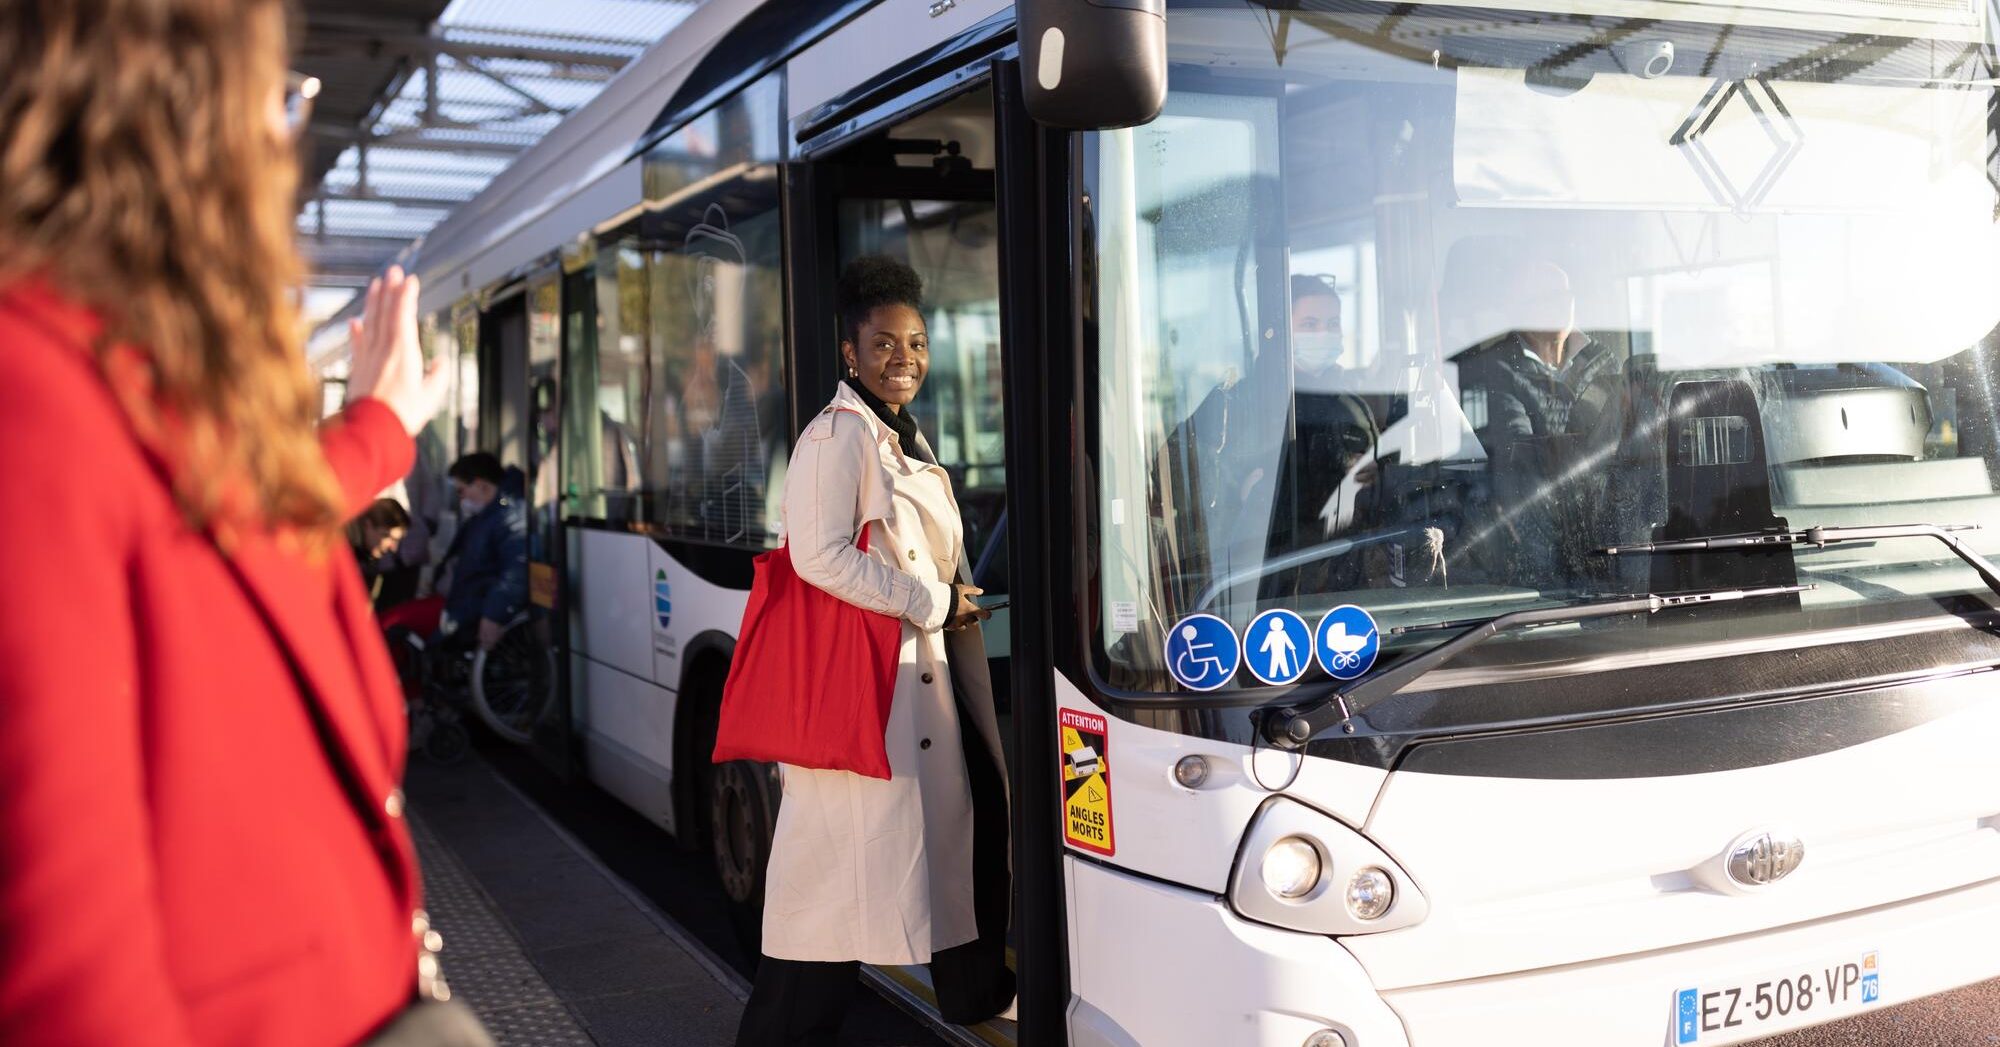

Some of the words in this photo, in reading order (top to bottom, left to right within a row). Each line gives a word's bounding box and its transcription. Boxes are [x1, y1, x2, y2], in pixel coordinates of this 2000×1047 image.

[1062, 712, 1104, 732] ATTENTION
[1070, 805, 1105, 826] ANGLES
[1072, 819, 1104, 841] MORTS
[1863, 978, 1877, 1000] 76
[1684, 1021, 1692, 1035] F
